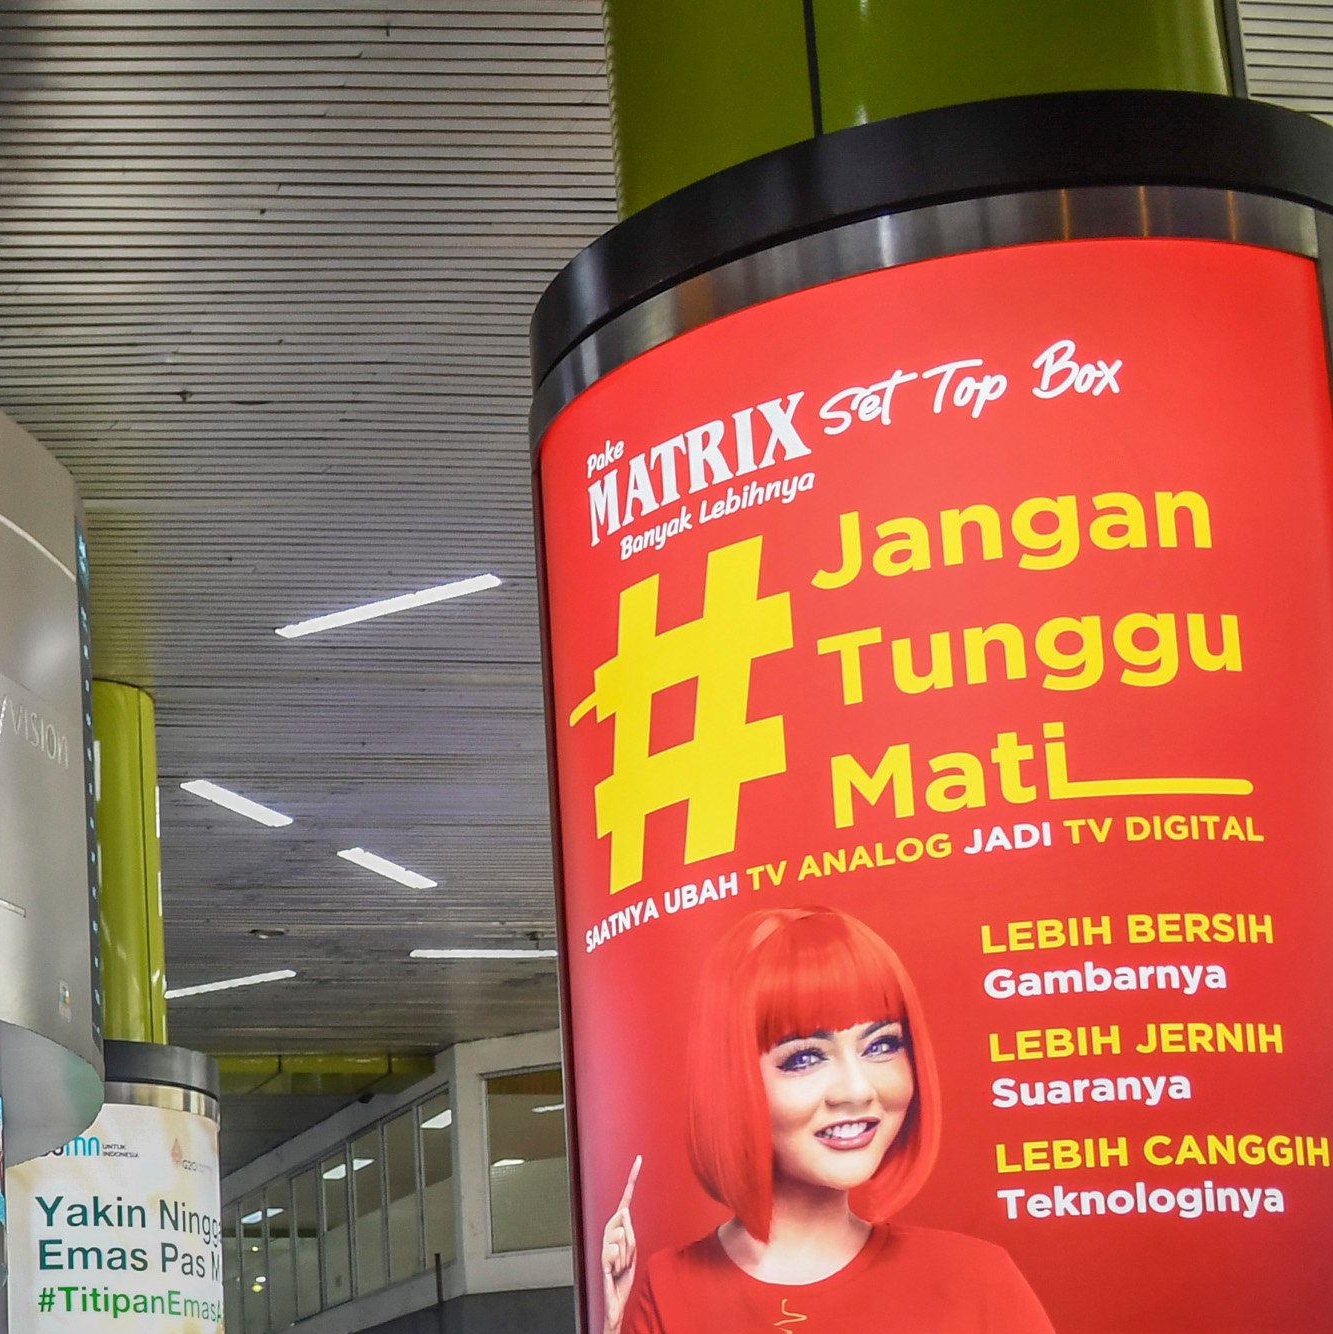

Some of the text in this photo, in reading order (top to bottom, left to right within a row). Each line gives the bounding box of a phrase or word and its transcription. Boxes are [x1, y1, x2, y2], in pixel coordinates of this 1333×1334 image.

[586, 338, 1123, 547] MATRIX Set Top Box
[586, 438, 625, 479] Pake
[619, 471, 815, 562] Banyak Lebihnya
[810, 489, 1213, 590] Jangan
[816, 611, 1244, 707] Tunggu
[570, 535, 796, 896] #
[830, 720, 1179, 830] Mati
[585, 814, 1265, 953] SAATNYA UBAH TV ANALOG JADI TV DIGITAL
[981, 913, 1274, 954] LEBIH BERSIH
[984, 961, 1227, 999] Gambarnya
[989, 1023, 1284, 1063] LEBIH JERNIH
[992, 1075, 1192, 1108] Suaranya
[996, 1134, 1331, 1173] LEBIH CANGGIH
[35, 1196, 146, 1228] Yakin
[997, 1180, 1285, 1220] Teknologinya
[38, 1239, 206, 1278] Emas Pas
